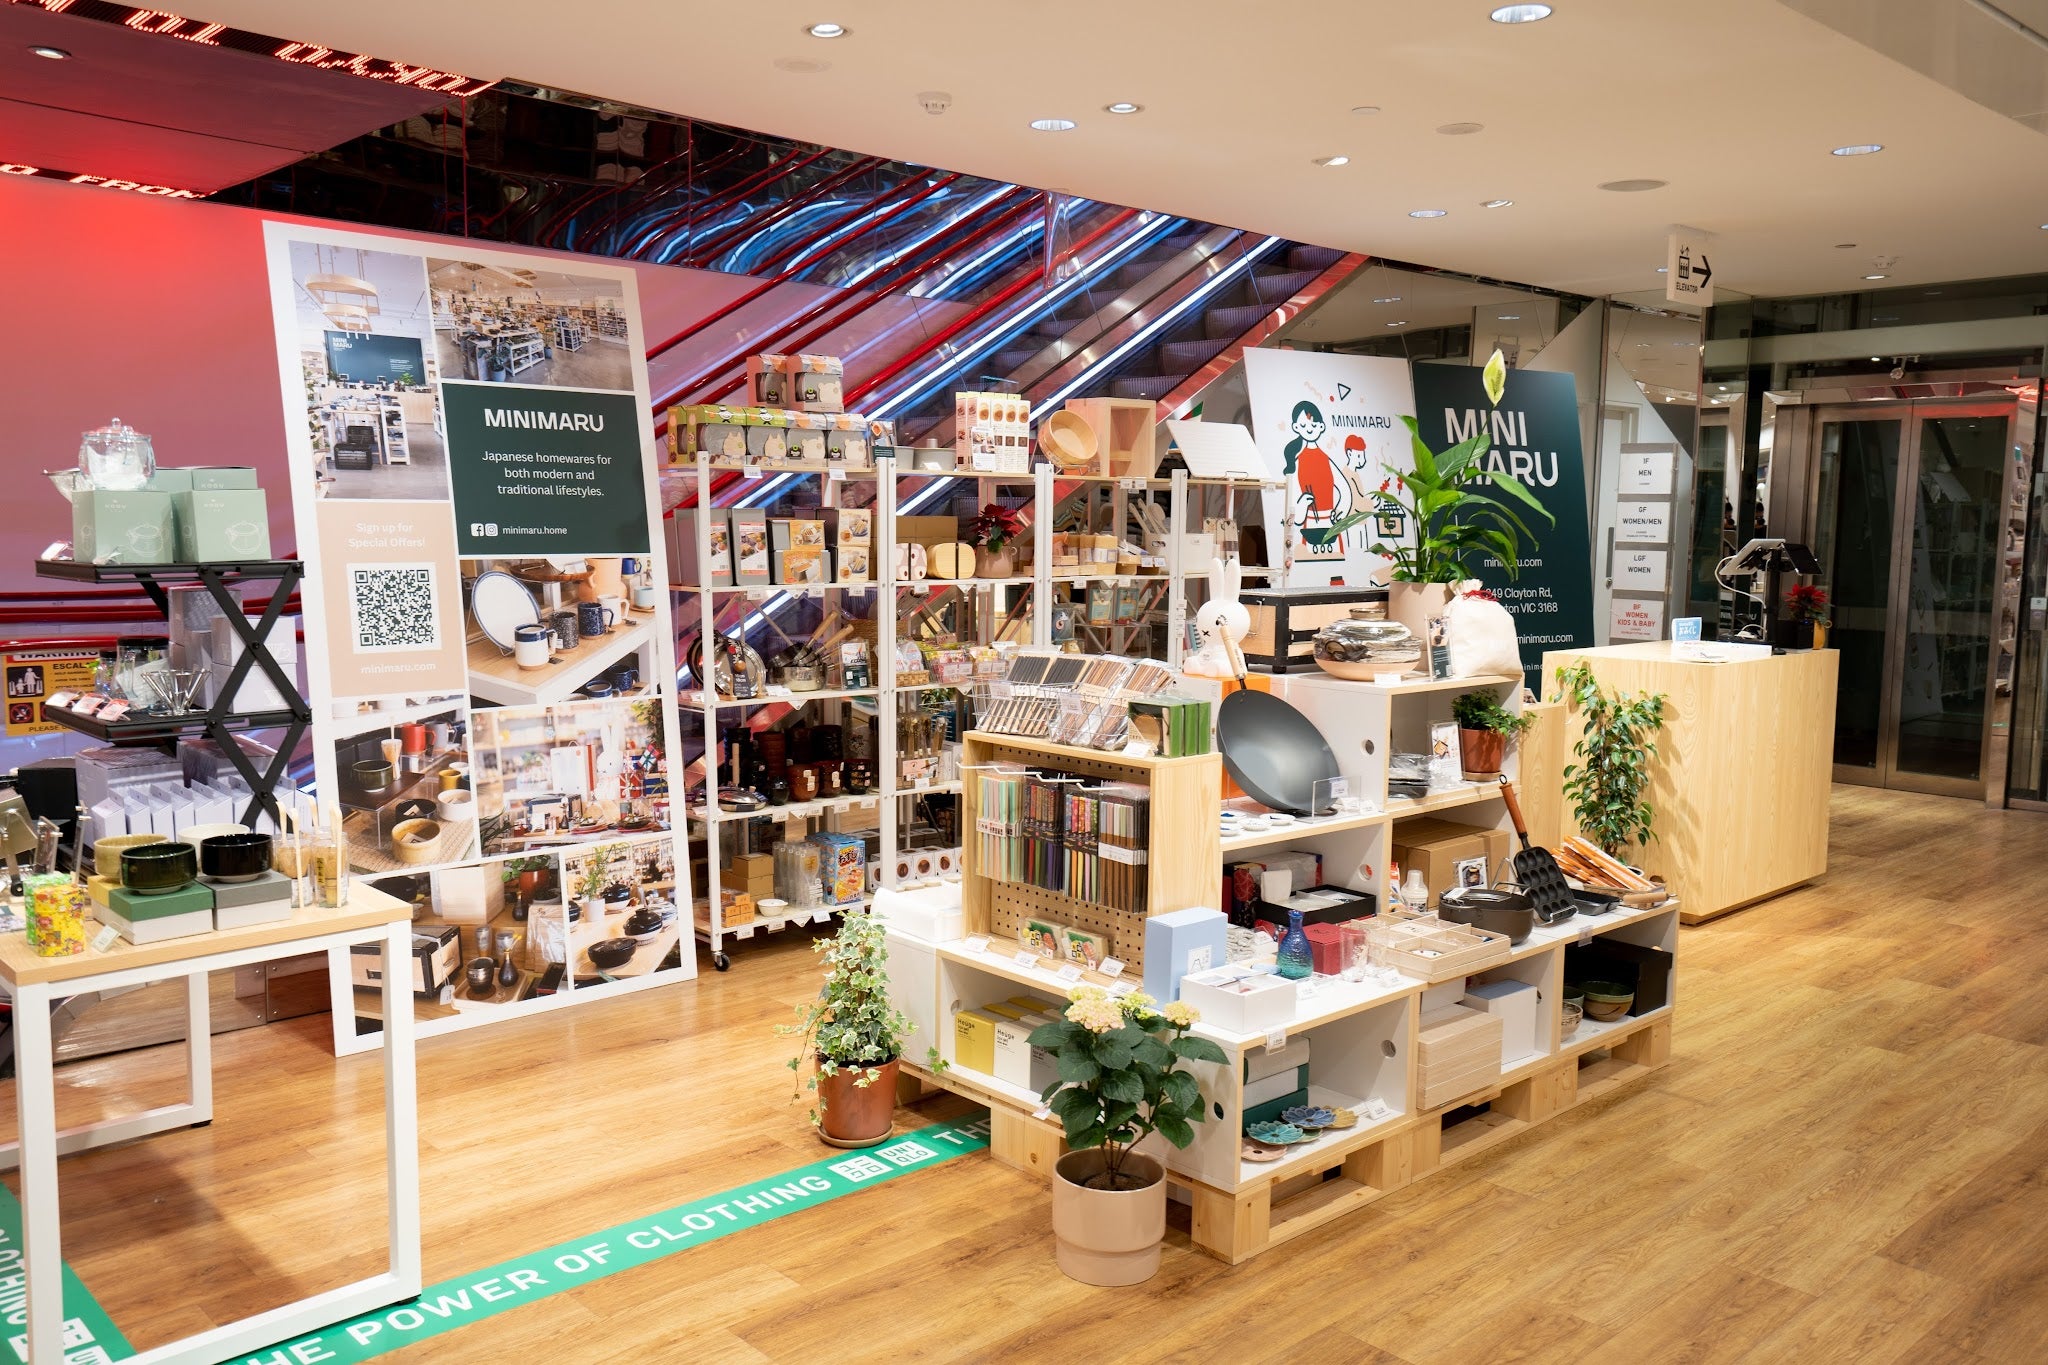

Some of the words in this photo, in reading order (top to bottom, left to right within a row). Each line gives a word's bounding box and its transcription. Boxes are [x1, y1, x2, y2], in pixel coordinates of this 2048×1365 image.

[484, 408, 605, 433] MINIMARU
[1331, 413, 1392, 430] MINIMARU
[1444, 407, 1528, 447] MINI
[482, 451, 534, 463] Japanese
[536, 452, 595, 464] homewares
[597, 455, 612, 465] for
[504, 468, 531, 479] both
[533, 469, 574, 480] modern
[576, 471, 595, 480] and
[497, 485, 554, 496] traditional
[556, 485, 605, 498] lifestyles.
[355, 522, 380, 535] Sign
[382, 524, 396, 533] up
[398, 521, 414, 532] for
[502, 525, 568, 535] minimaru.home
[348, 537, 388, 549] Special
[390, 536, 425, 547] Offers!
[1484, 557, 1543, 568] minu.com
[1504, 587, 1538, 600] Clayton
[1538, 587, 1553, 598] Rd,
[1520, 602, 1536, 613] VIC
[1538, 602, 1558, 613] 3168
[1617, 618, 1631, 626] KIDS
[1517, 633, 1574, 644] minimaru.com
[361, 661, 436, 674] minimaru.com
[231, 1337, 337, 1365] HE
[345, 1268, 549, 1346] POWER
[553, 1242, 611, 1275] OF
[625, 1174, 832, 1250] CLOTHING
